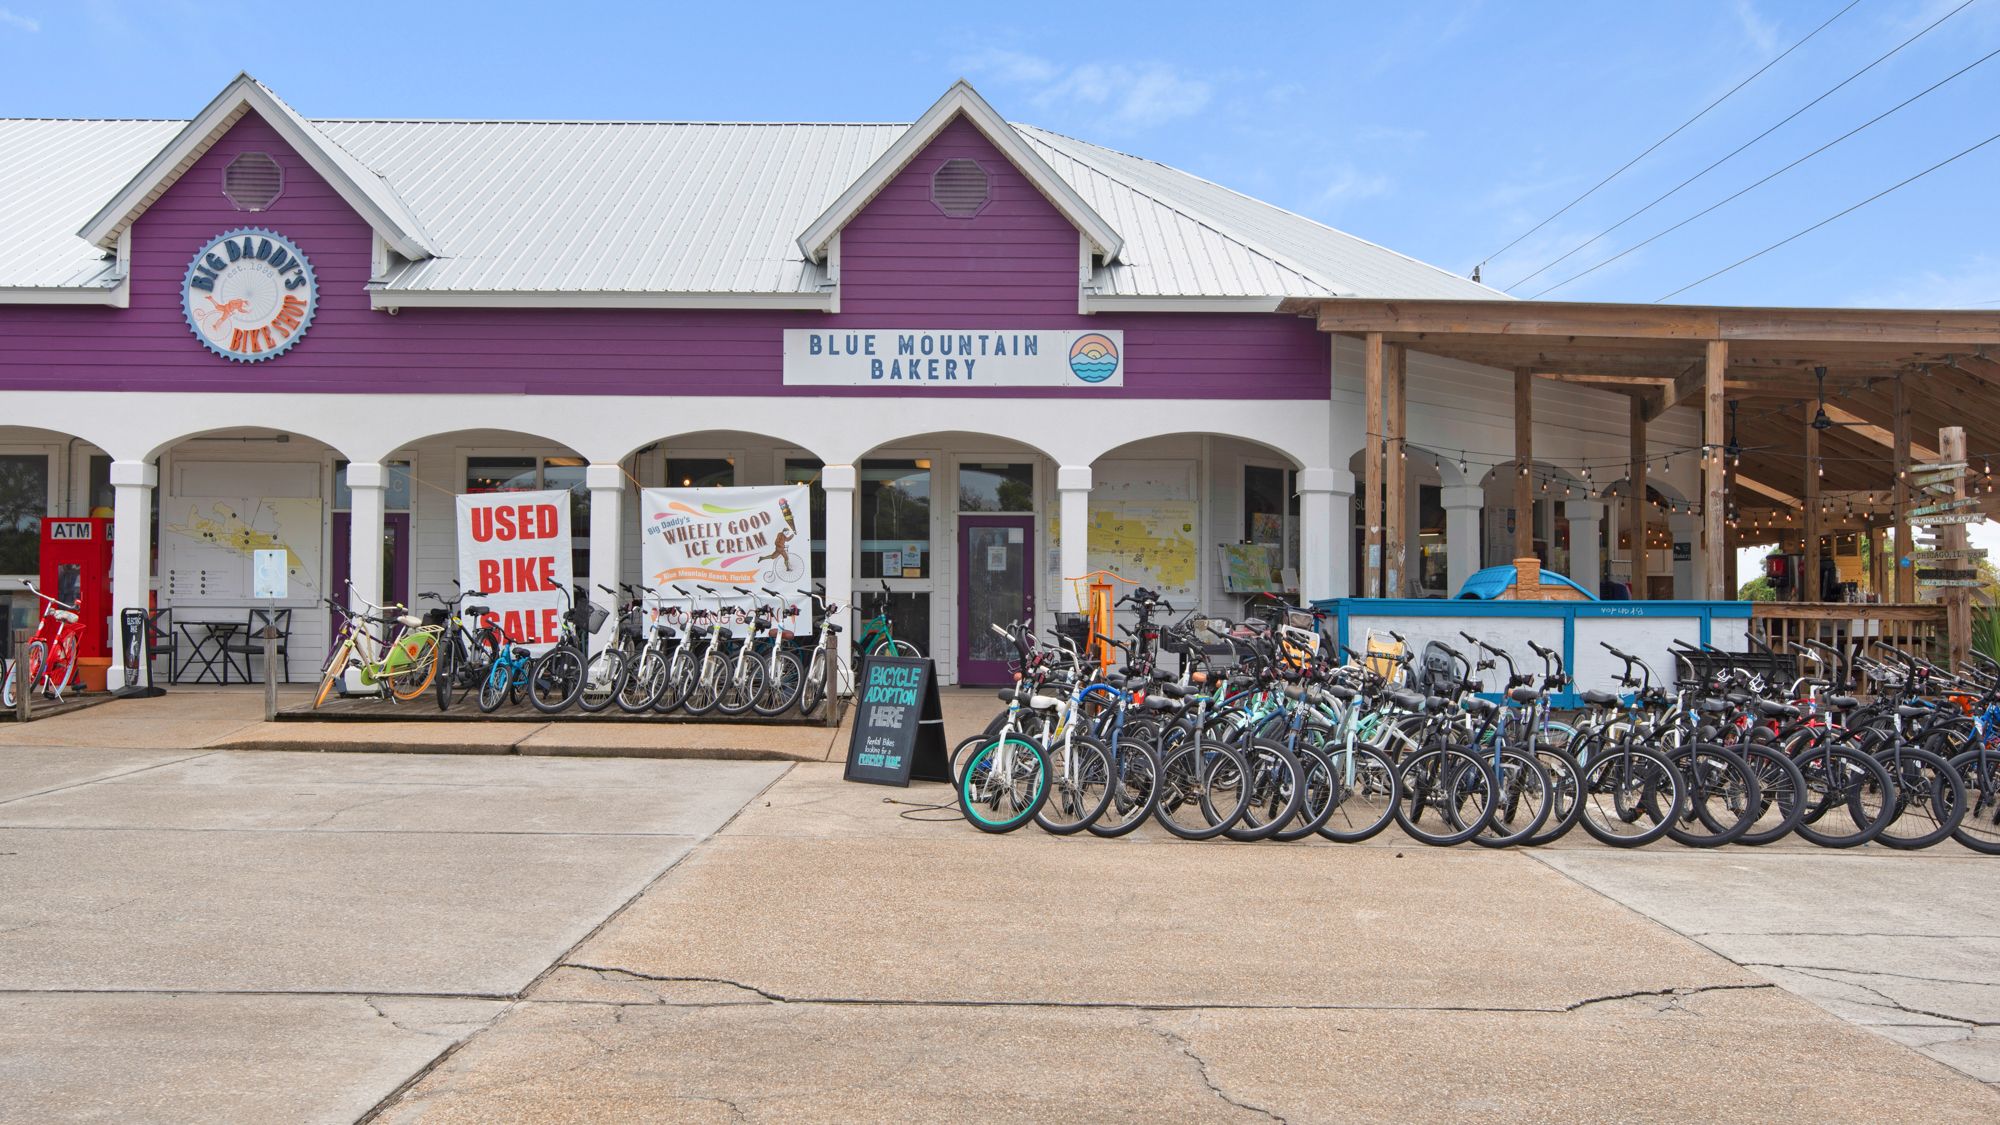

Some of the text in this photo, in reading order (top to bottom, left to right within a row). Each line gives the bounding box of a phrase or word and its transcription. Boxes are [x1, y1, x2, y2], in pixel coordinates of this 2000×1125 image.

[191, 237, 307, 292] BIG DADDY'S
[229, 295, 307, 353] BIKE SHOP
[809, 334, 1038, 356] BLUE MOUNTAIN
[871, 359, 976, 380] BAKERY
[54, 523, 90, 538] ATM
[471, 504, 559, 543] USED
[648, 516, 690, 535] Big Daddy's
[663, 511, 771, 545] WHEELY GOOD
[684, 531, 769, 558] ICE CREAM
[479, 556, 557, 595] BIKE
[678, 569, 708, 578] Mountain
[480, 608, 560, 647] SALE
[735, 608, 781, 625] SON
[869, 665, 921, 688] BICYCLE
[864, 686, 917, 706] ADOPTION
[868, 705, 905, 729] HERE
[866, 736, 895, 747] Rental Bikes
